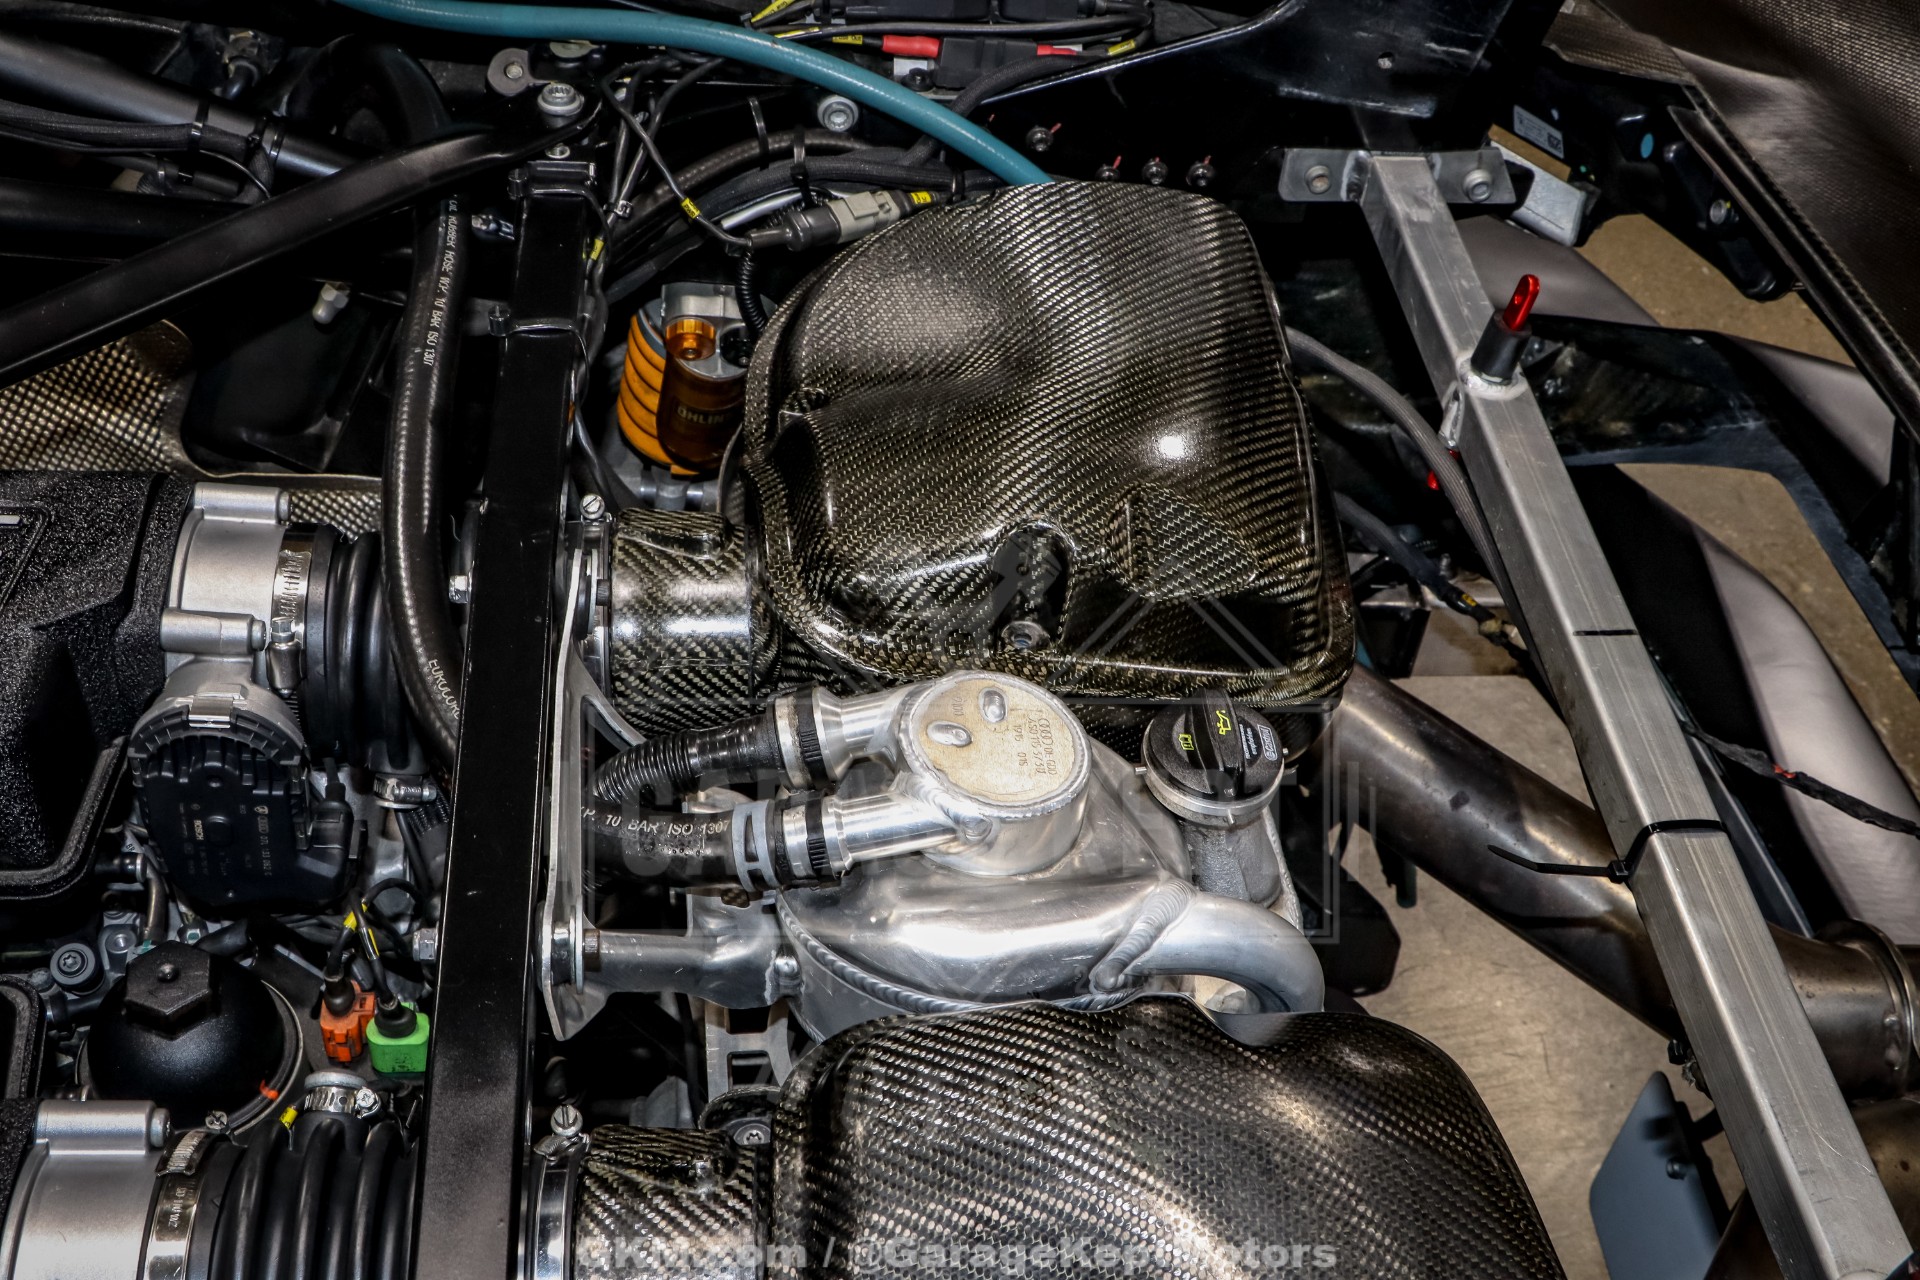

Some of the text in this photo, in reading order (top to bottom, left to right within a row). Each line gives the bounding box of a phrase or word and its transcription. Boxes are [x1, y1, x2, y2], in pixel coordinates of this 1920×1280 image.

[193, 820, 204, 841] BOSCH
[605, 814, 622, 827] 10
[628, 820, 659, 833] BAR
[667, 822, 694, 835] ISO
[700, 820, 731, 835] 1307
